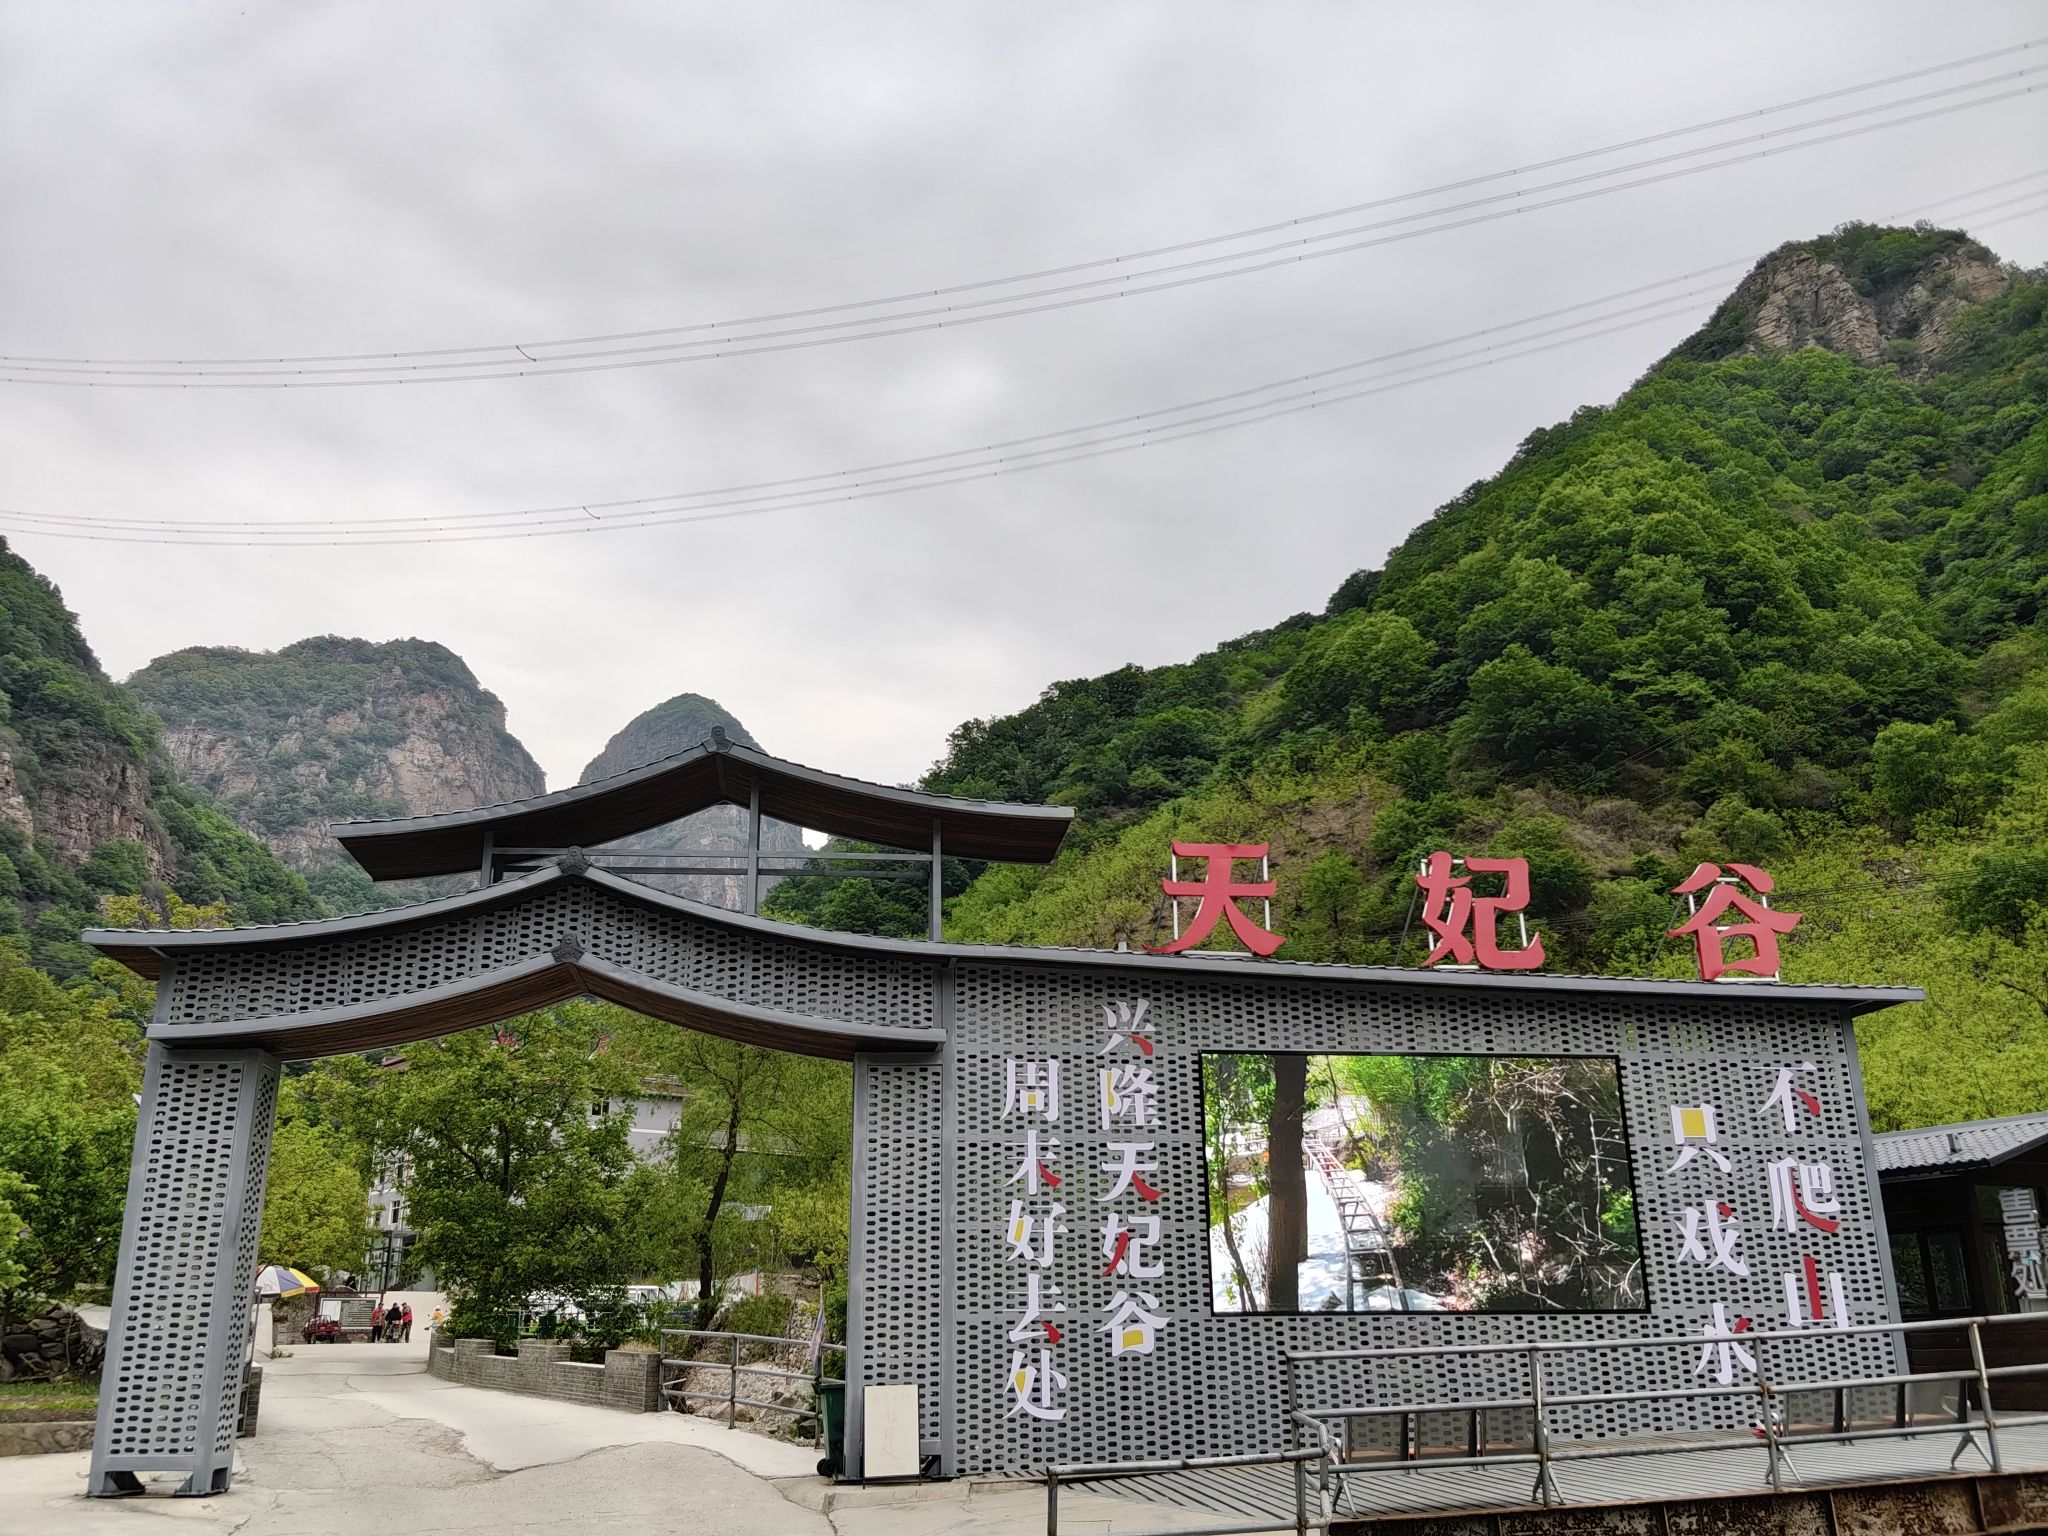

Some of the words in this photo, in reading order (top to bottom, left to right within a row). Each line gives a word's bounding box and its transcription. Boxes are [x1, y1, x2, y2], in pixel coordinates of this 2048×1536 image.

[1141, 840, 1803, 981] 天妃谷
[1000, 1058, 1068, 1422] 周末好去处
[1094, 998, 1171, 1357] 兴隆天妃谷
[1666, 1103, 1758, 1385] 只戏水
[1751, 1061, 1848, 1330] 不爬山
